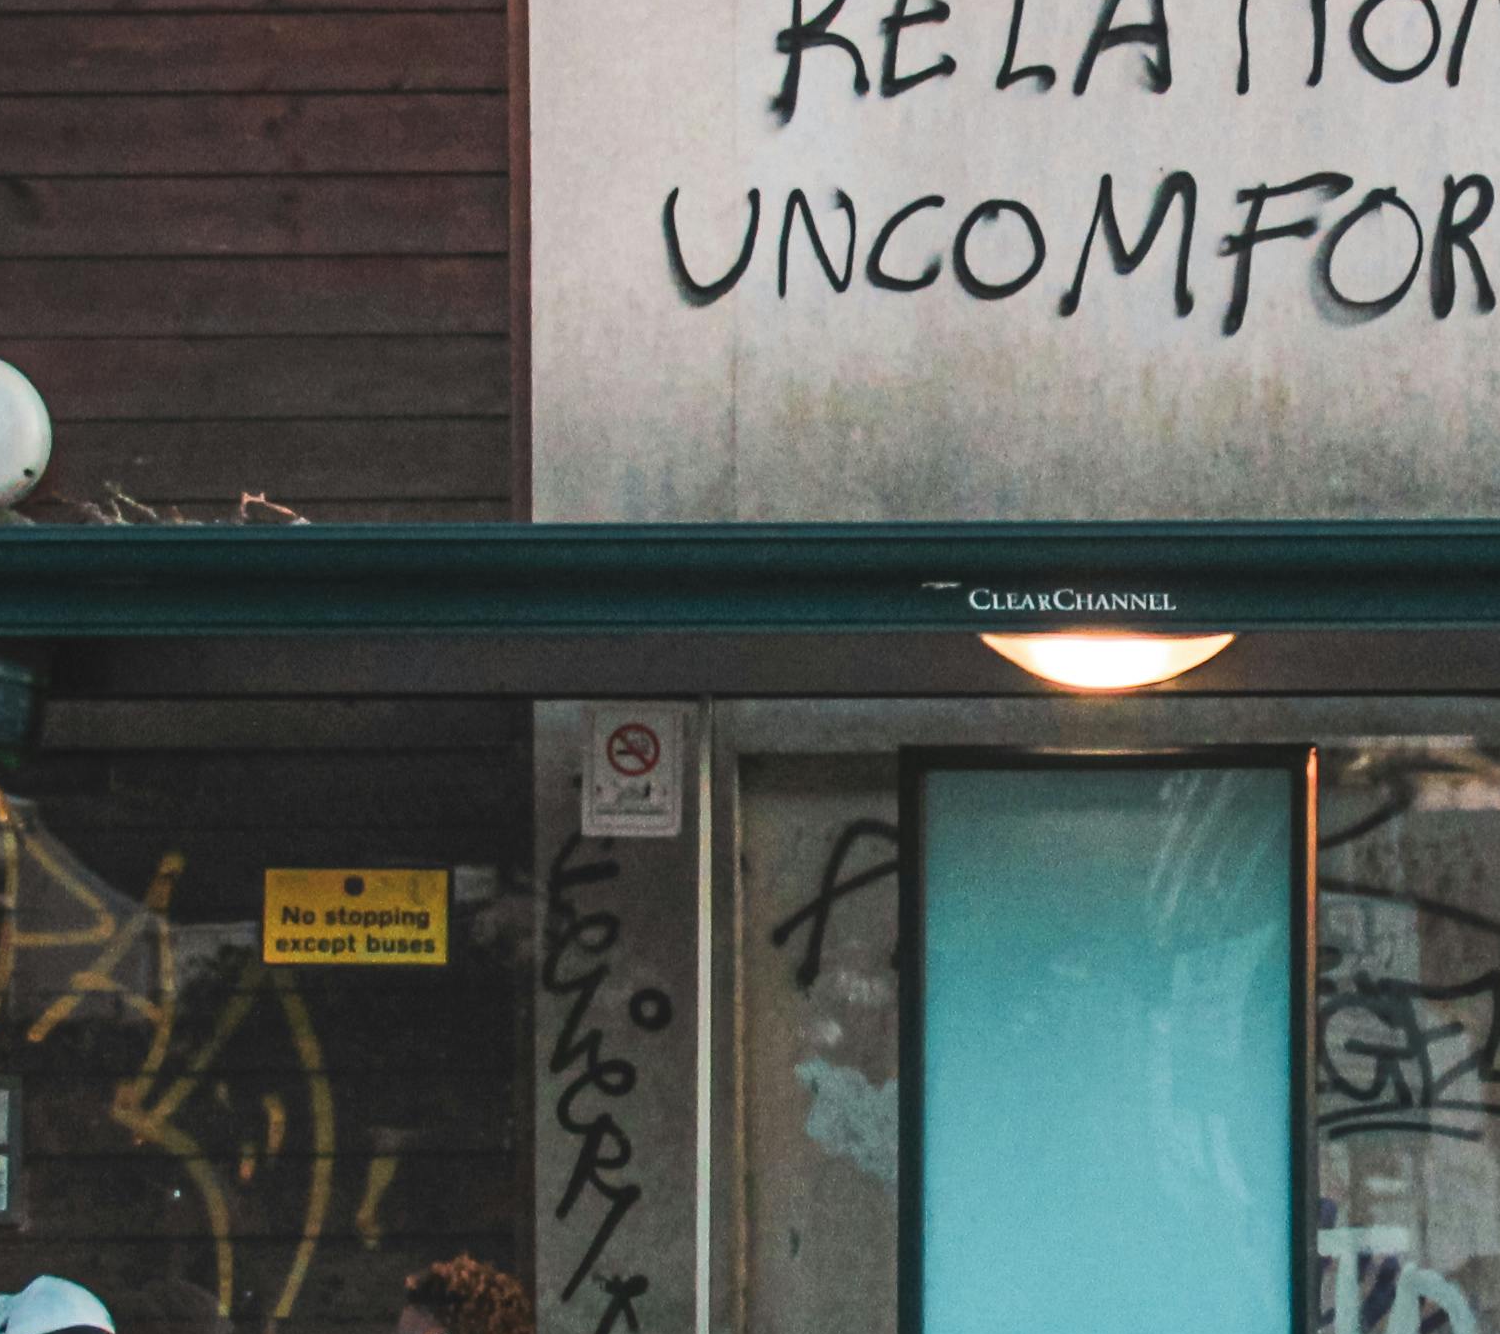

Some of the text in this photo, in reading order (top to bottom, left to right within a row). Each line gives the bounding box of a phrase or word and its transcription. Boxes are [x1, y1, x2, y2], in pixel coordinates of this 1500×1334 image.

[281, 906, 430, 930] No stopping
[275, 934, 436, 955] except buses
